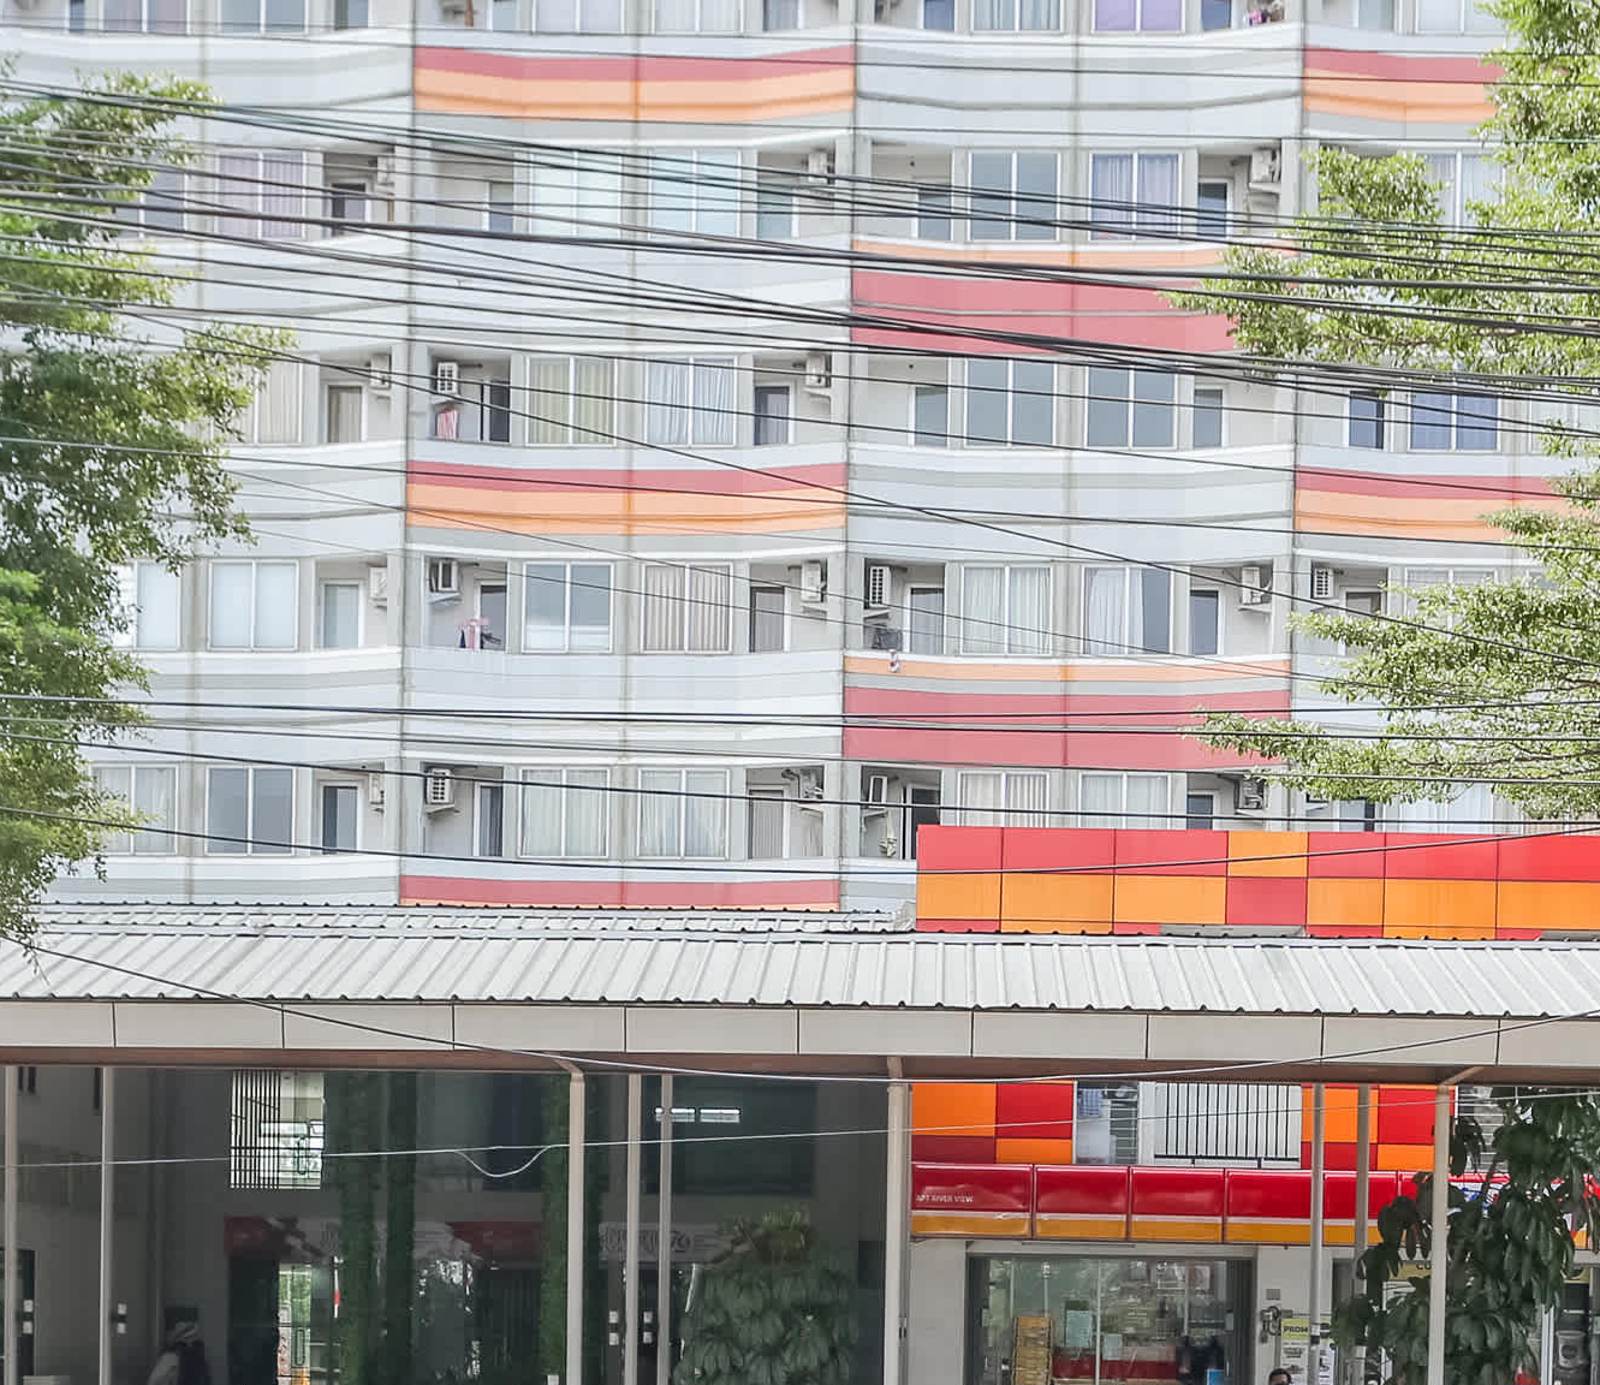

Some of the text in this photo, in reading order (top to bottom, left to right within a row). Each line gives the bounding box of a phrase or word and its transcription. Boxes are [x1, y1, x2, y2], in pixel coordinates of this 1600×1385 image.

[931, 1195, 953, 1203] RIVER
[954, 1195, 974, 1203] VIEW
[1283, 1325, 1309, 1334] PROM
